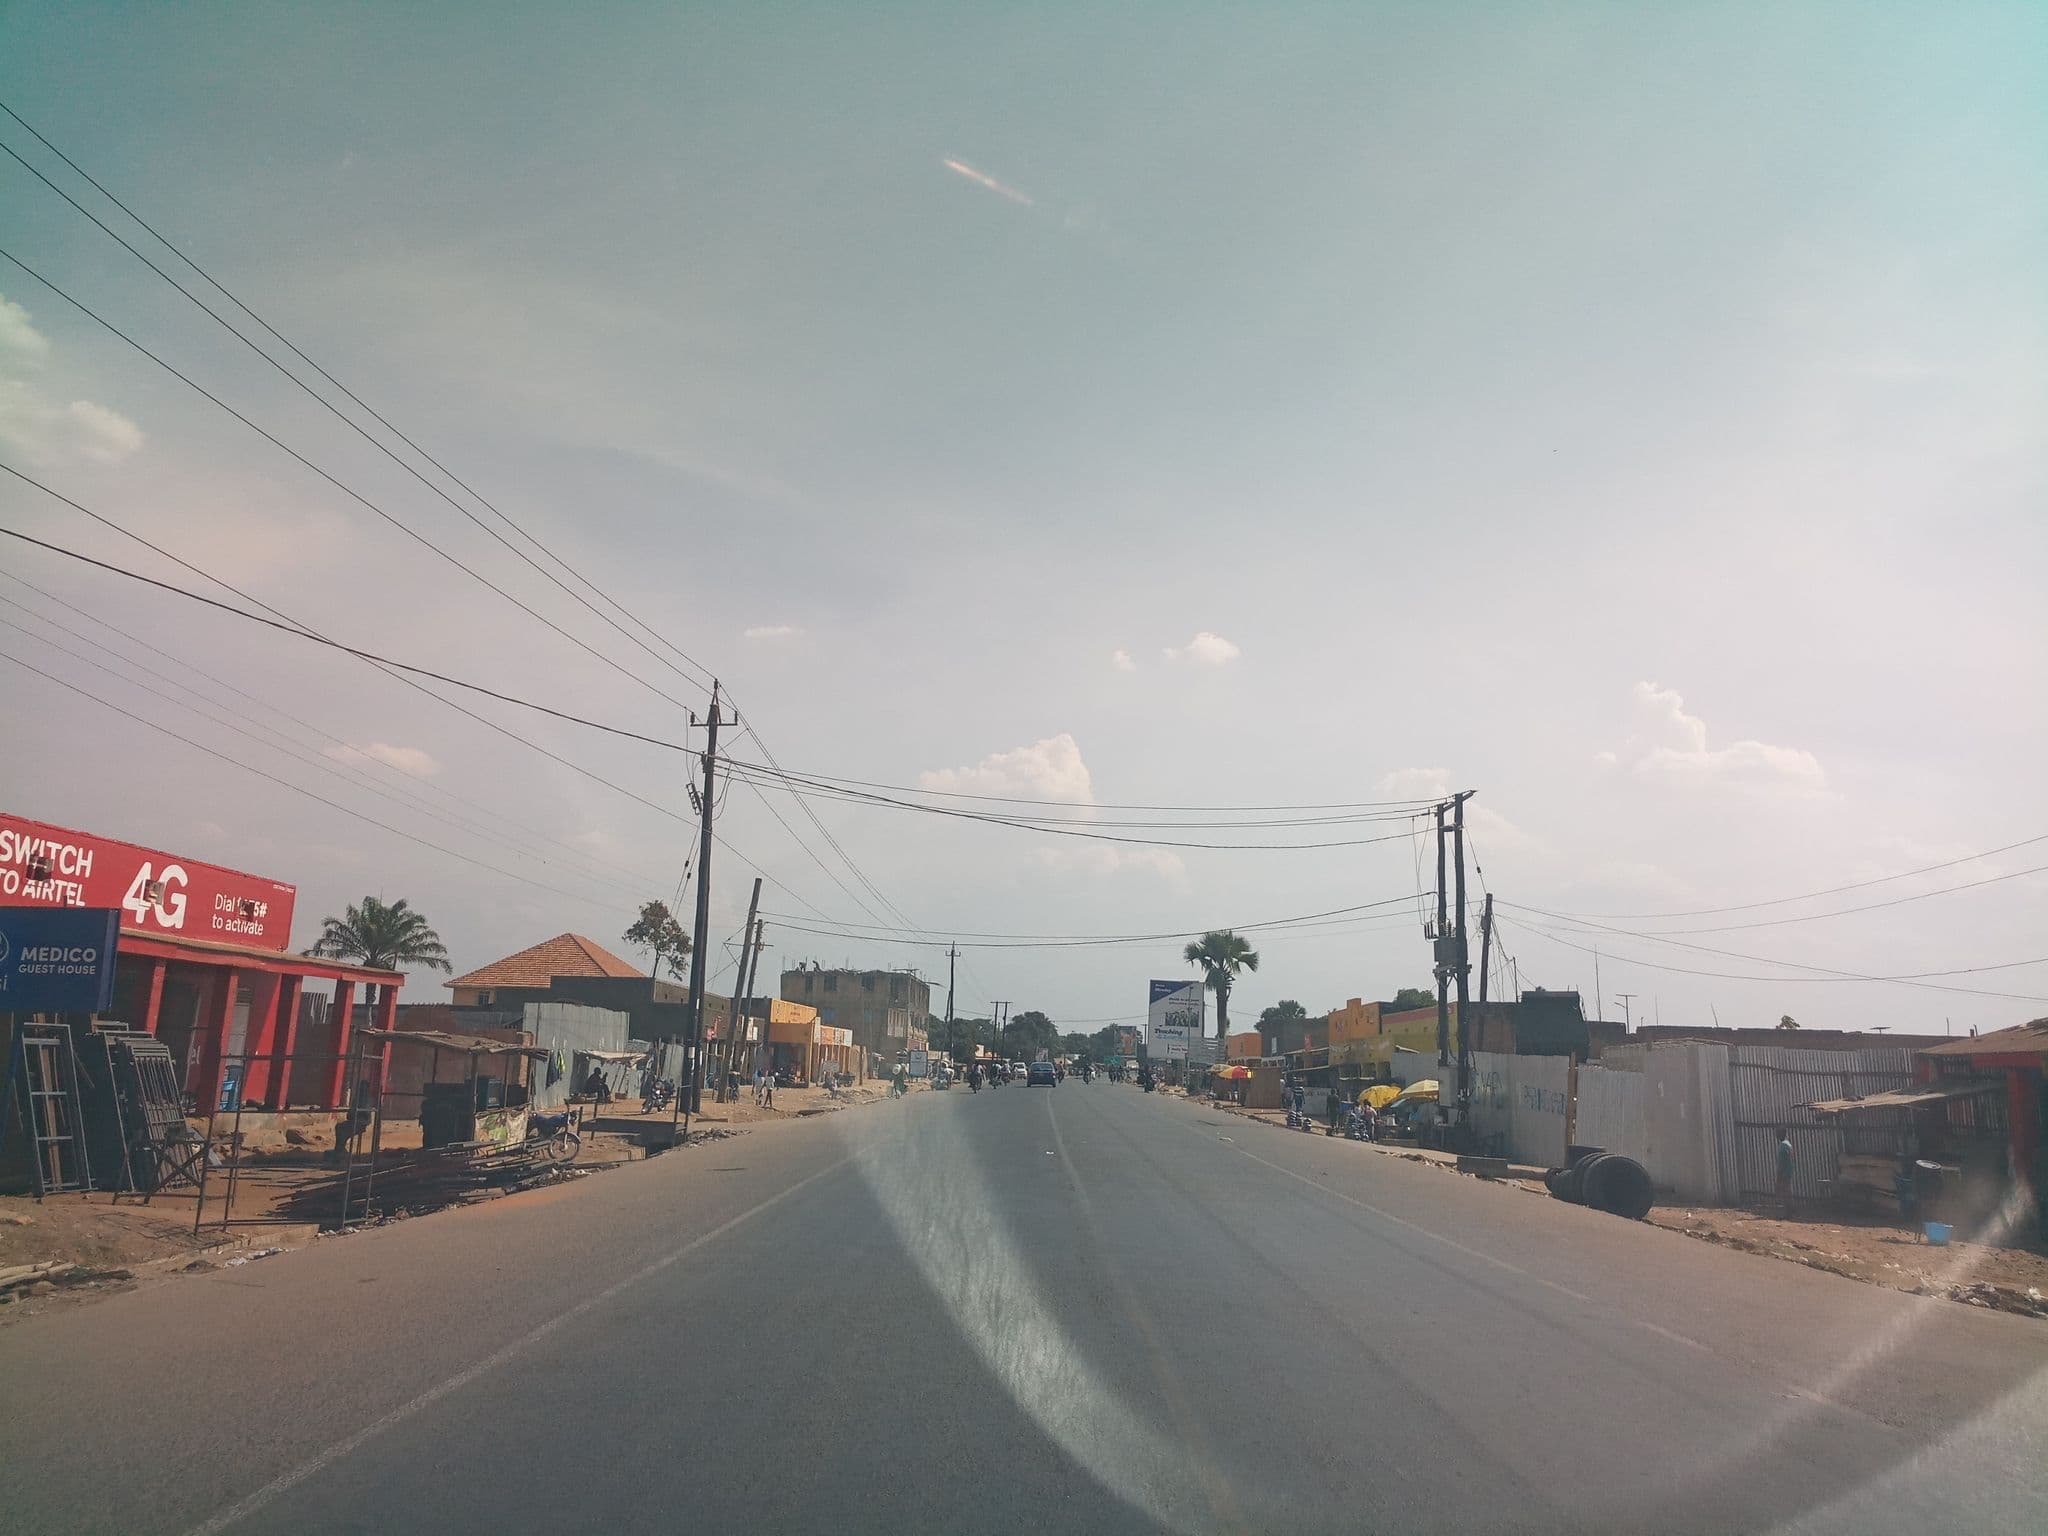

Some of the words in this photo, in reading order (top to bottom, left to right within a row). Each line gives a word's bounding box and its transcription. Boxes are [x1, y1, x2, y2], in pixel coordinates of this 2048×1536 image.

[0, 830, 93, 878] SWITCH
[22, 879, 85, 906] AIRTEL
[122, 861, 188, 929] 4G
[215, 893, 235, 912] Dial
[212, 914, 223, 929] to
[225, 918, 263, 935] activate
[21, 947, 96, 962] MEDICO
[19, 964, 55, 973] GUEST
[58, 965, 96, 974] HOUSE
